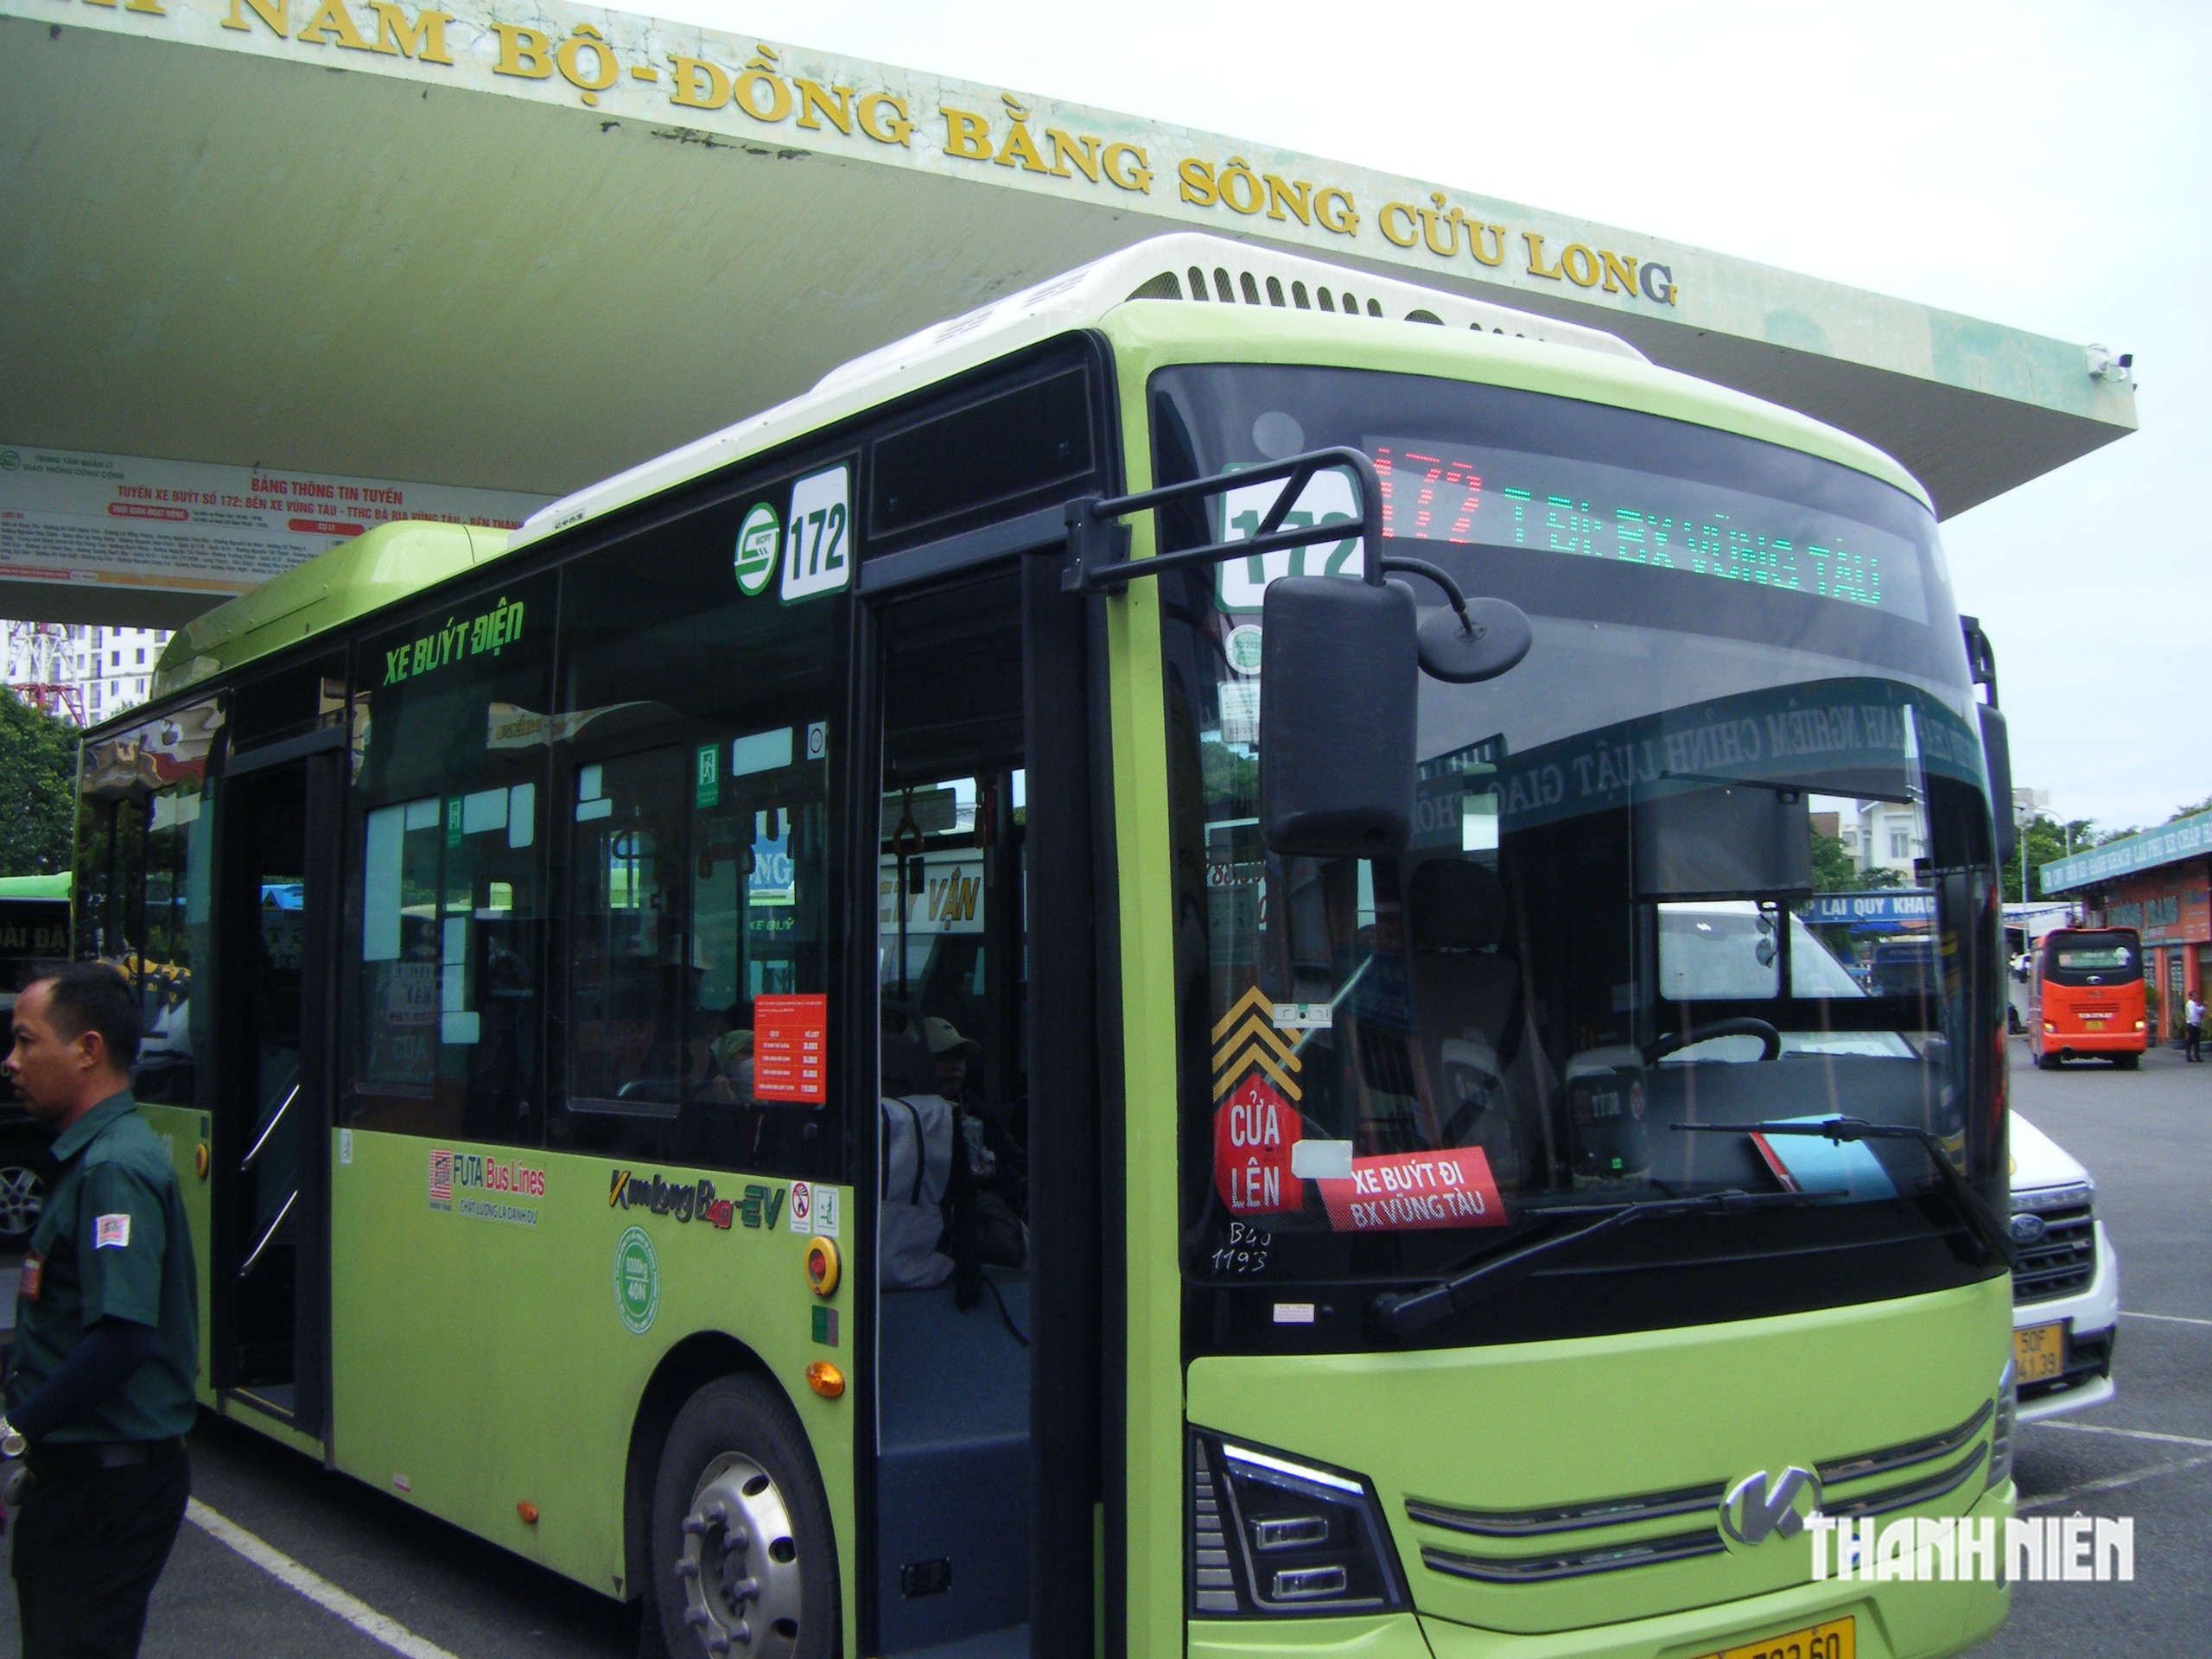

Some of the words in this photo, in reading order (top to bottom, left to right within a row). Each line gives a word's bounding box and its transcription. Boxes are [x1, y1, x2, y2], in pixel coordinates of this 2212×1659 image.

[222, 0, 454, 66] NAM
[941, 93, 1155, 194] BẰNG
[1179, 156, 1360, 237] SÔNG
[1380, 192, 1505, 266] CỬU
[1522, 232, 1678, 306] LONG
[117, 484, 152, 500] TUYẾN
[156, 488, 170, 501] XE
[172, 489, 200, 505] BUÝT
[201, 490, 218, 505] SỐ
[219, 495, 243, 509] 172:
[245, 494, 267, 510] BẾN
[270, 499, 284, 512] XE
[287, 499, 315, 514] VŨNG
[317, 501, 337, 517] TÀU
[346, 506, 372, 519] TTHC
[251, 474, 288, 494] BẢNG
[292, 480, 334, 499] THÔNG
[339, 486, 359, 501] TIN
[363, 486, 404, 505] TUYẾN
[1372, 447, 1482, 546] 172
[1616, 508, 1674, 569] BX
[791, 501, 847, 581] 172
[1230, 508, 1364, 585] 172
[383, 648, 413, 687] XE
[411, 617, 469, 677] BUÝT
[1230, 1090, 1281, 1147] CỬA
[454, 1154, 484, 1188] FUTA
[486, 1157, 510, 1192] Bus
[511, 1160, 546, 1198] Lines
[1230, 1156, 1281, 1210] LÊN
[1352, 1166, 1380, 1196] XE
[1383, 1159, 1435, 1193] BUÝT
[1440, 1160, 1465, 1186] ĐI
[1350, 1200, 1385, 1229] BX
[1385, 1190, 1445, 1227] VŨNG
[1442, 1189, 1486, 1218] TÀU
